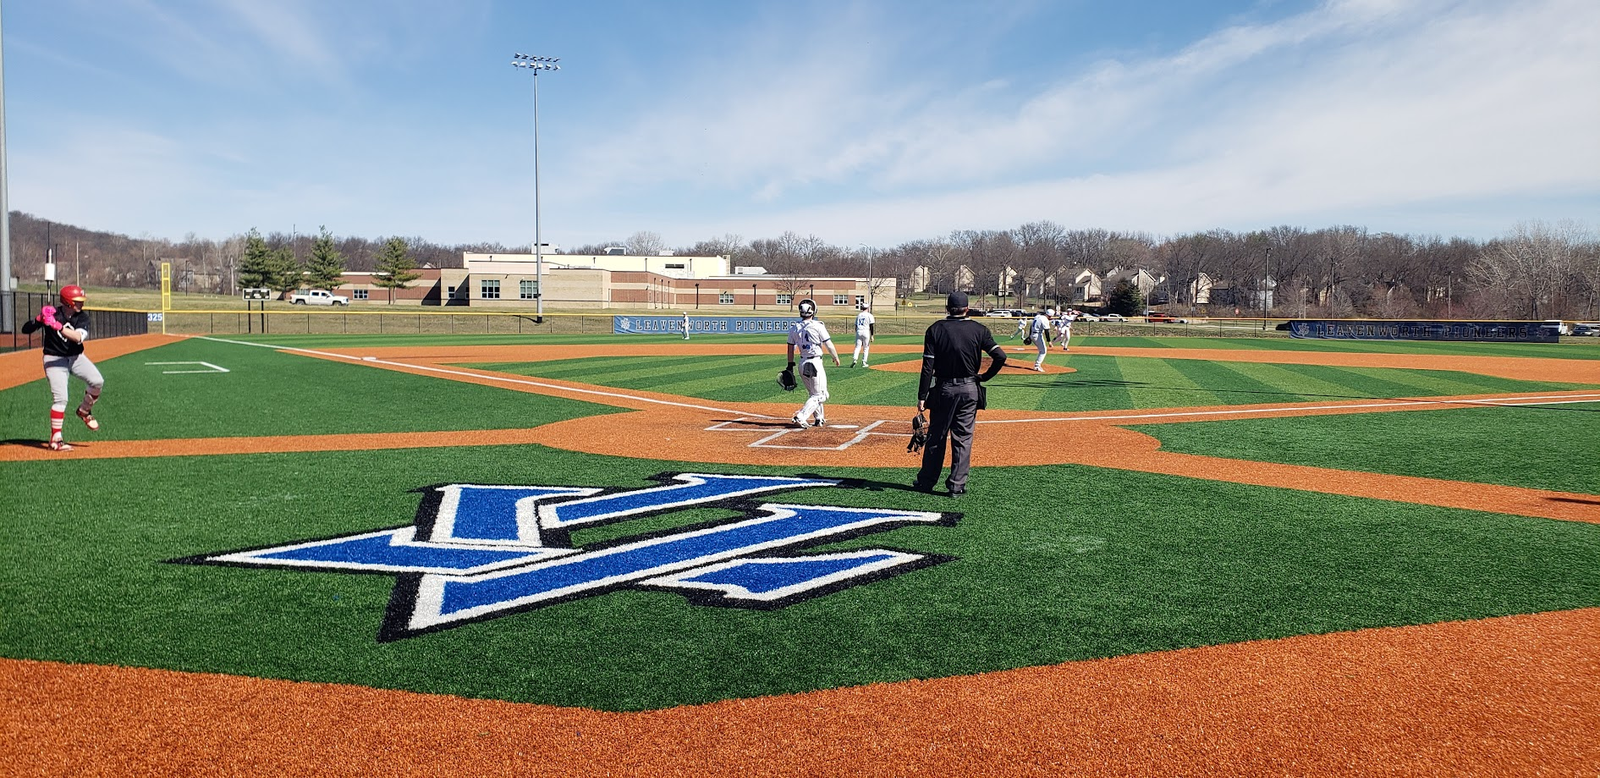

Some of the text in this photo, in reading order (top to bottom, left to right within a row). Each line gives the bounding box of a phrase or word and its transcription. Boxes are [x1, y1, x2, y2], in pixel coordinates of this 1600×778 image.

[147, 313, 163, 322] 325
[635, 320, 728, 331] LEAVENWORTH
[1316, 324, 1527, 340] LEAVENWORTH PIONEERS
